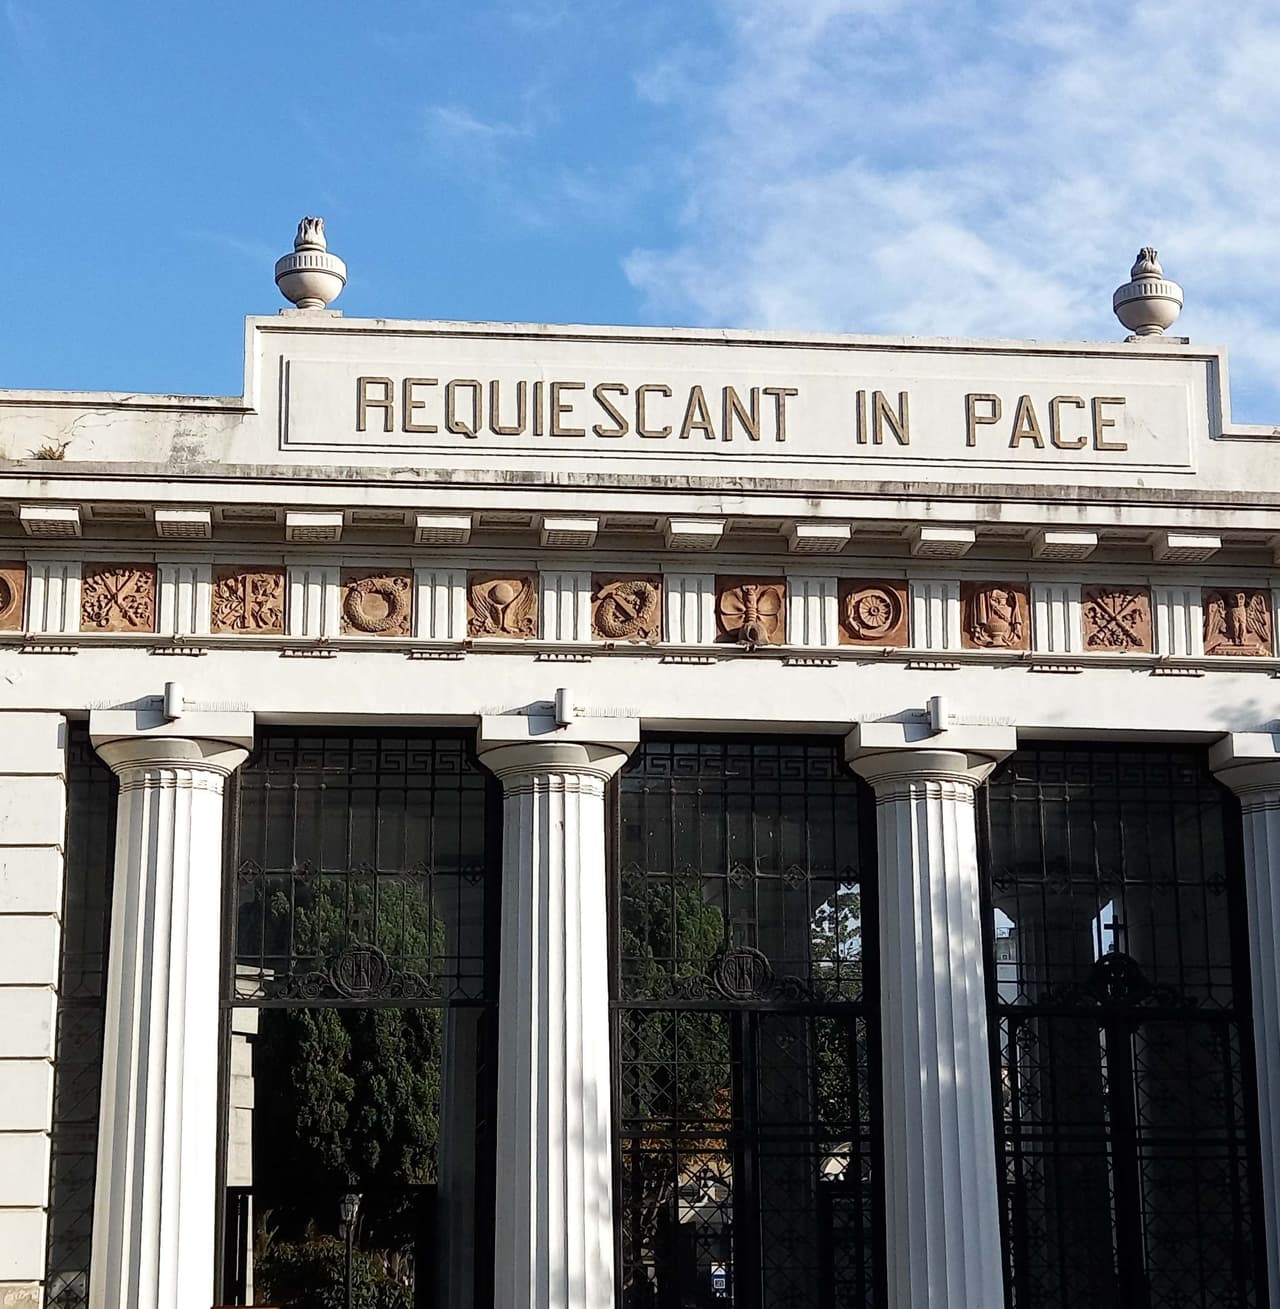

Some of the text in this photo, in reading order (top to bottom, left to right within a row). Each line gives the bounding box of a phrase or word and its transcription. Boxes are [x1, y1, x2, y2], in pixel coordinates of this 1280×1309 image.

[355, 376, 1130, 452] REQUIESCANT IN PACE
